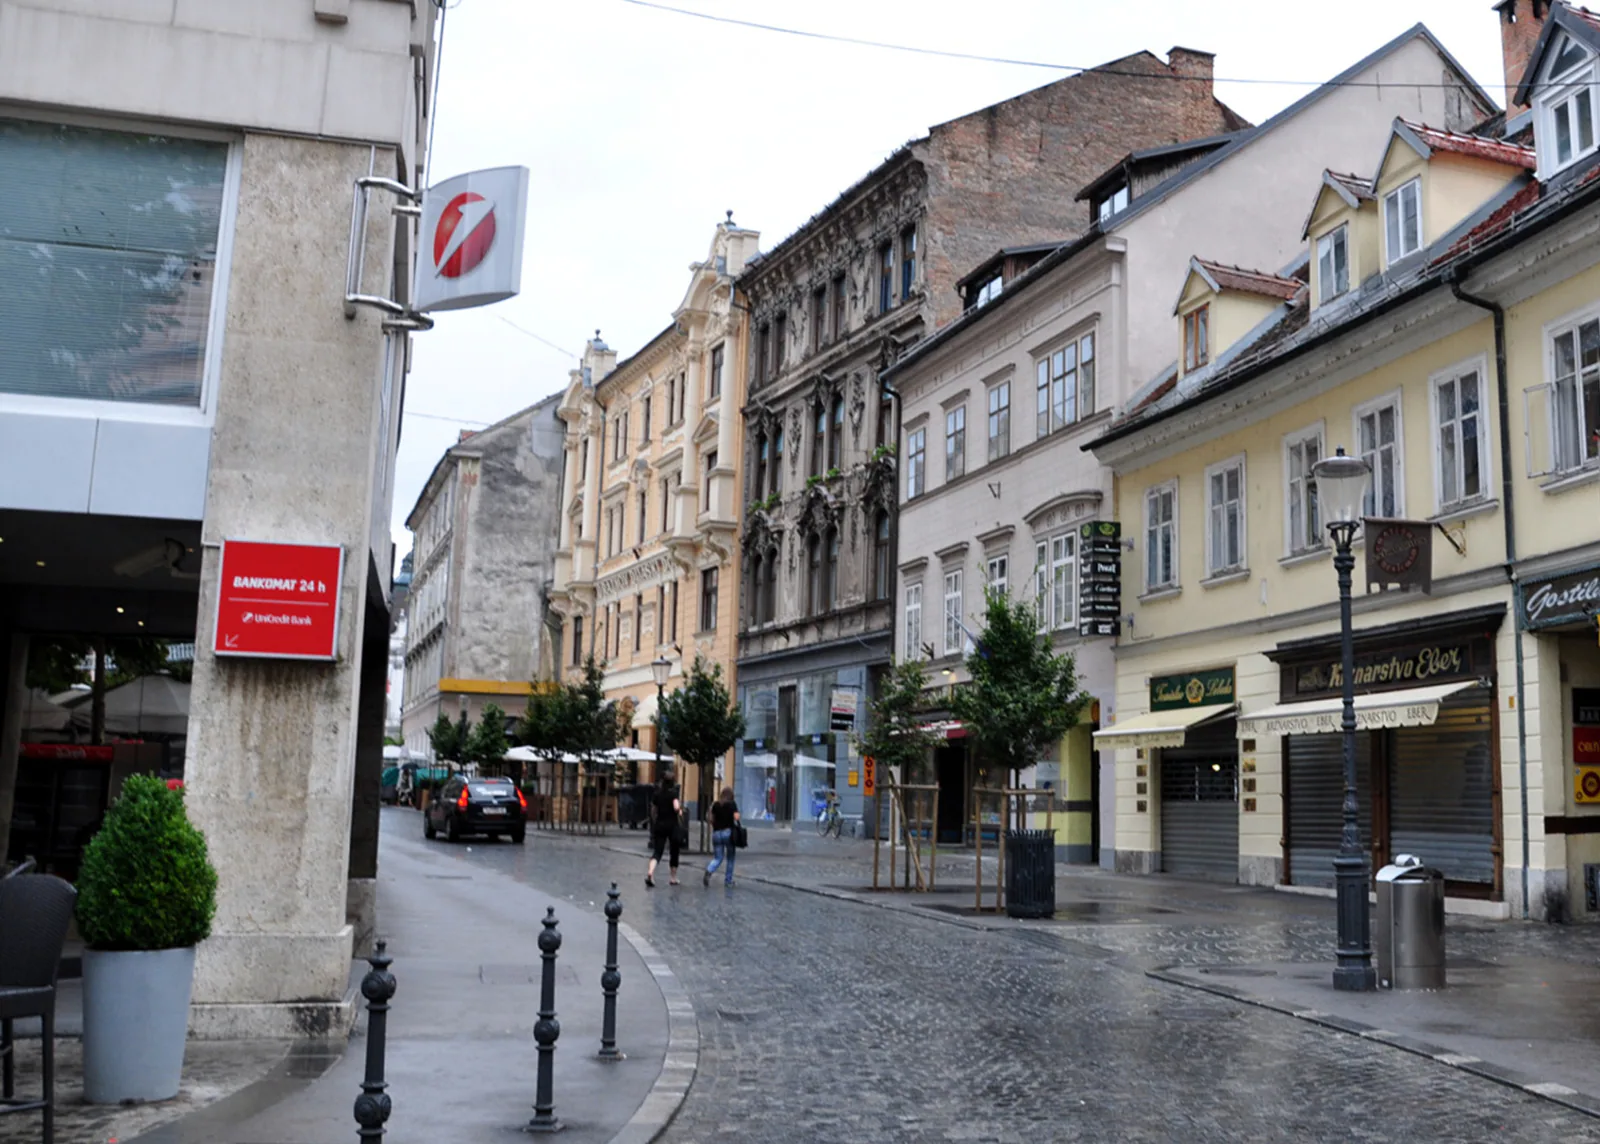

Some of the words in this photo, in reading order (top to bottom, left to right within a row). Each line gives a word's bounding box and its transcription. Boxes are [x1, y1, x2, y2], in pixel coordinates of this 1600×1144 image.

[233, 576, 297, 591] BANKOMAT
[299, 580, 315, 593] 24
[318, 581, 326, 593] h
[291, 615, 312, 626] Bank
[1406, 706, 1431, 720] EBER
[864, 753, 874, 789] OTO
